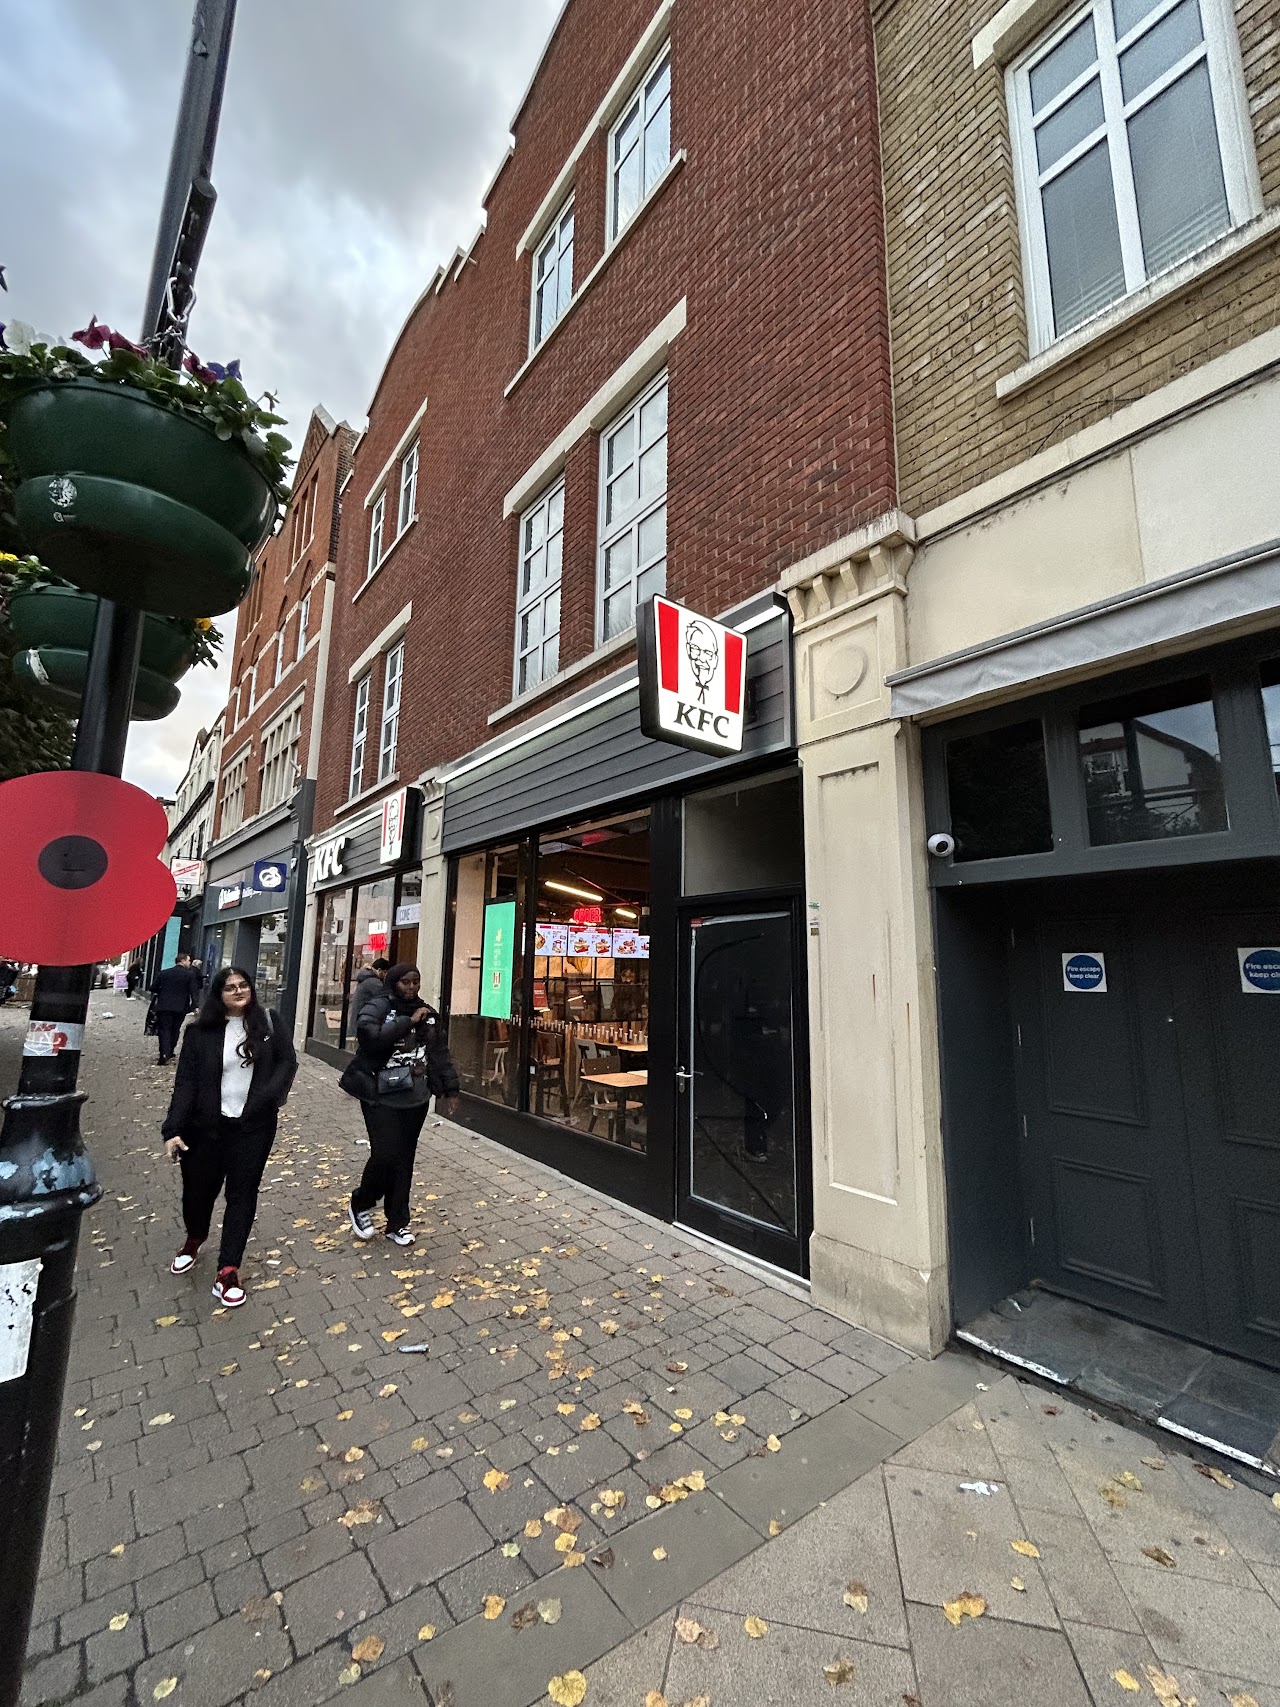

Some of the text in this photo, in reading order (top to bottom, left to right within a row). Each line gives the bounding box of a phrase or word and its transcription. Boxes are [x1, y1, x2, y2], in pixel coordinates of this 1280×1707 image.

[673, 701, 730, 738] KFC
[311, 836, 346, 883] KFC
[573, 907, 602, 923] ORDER
[1249, 971, 1270, 979] keep
